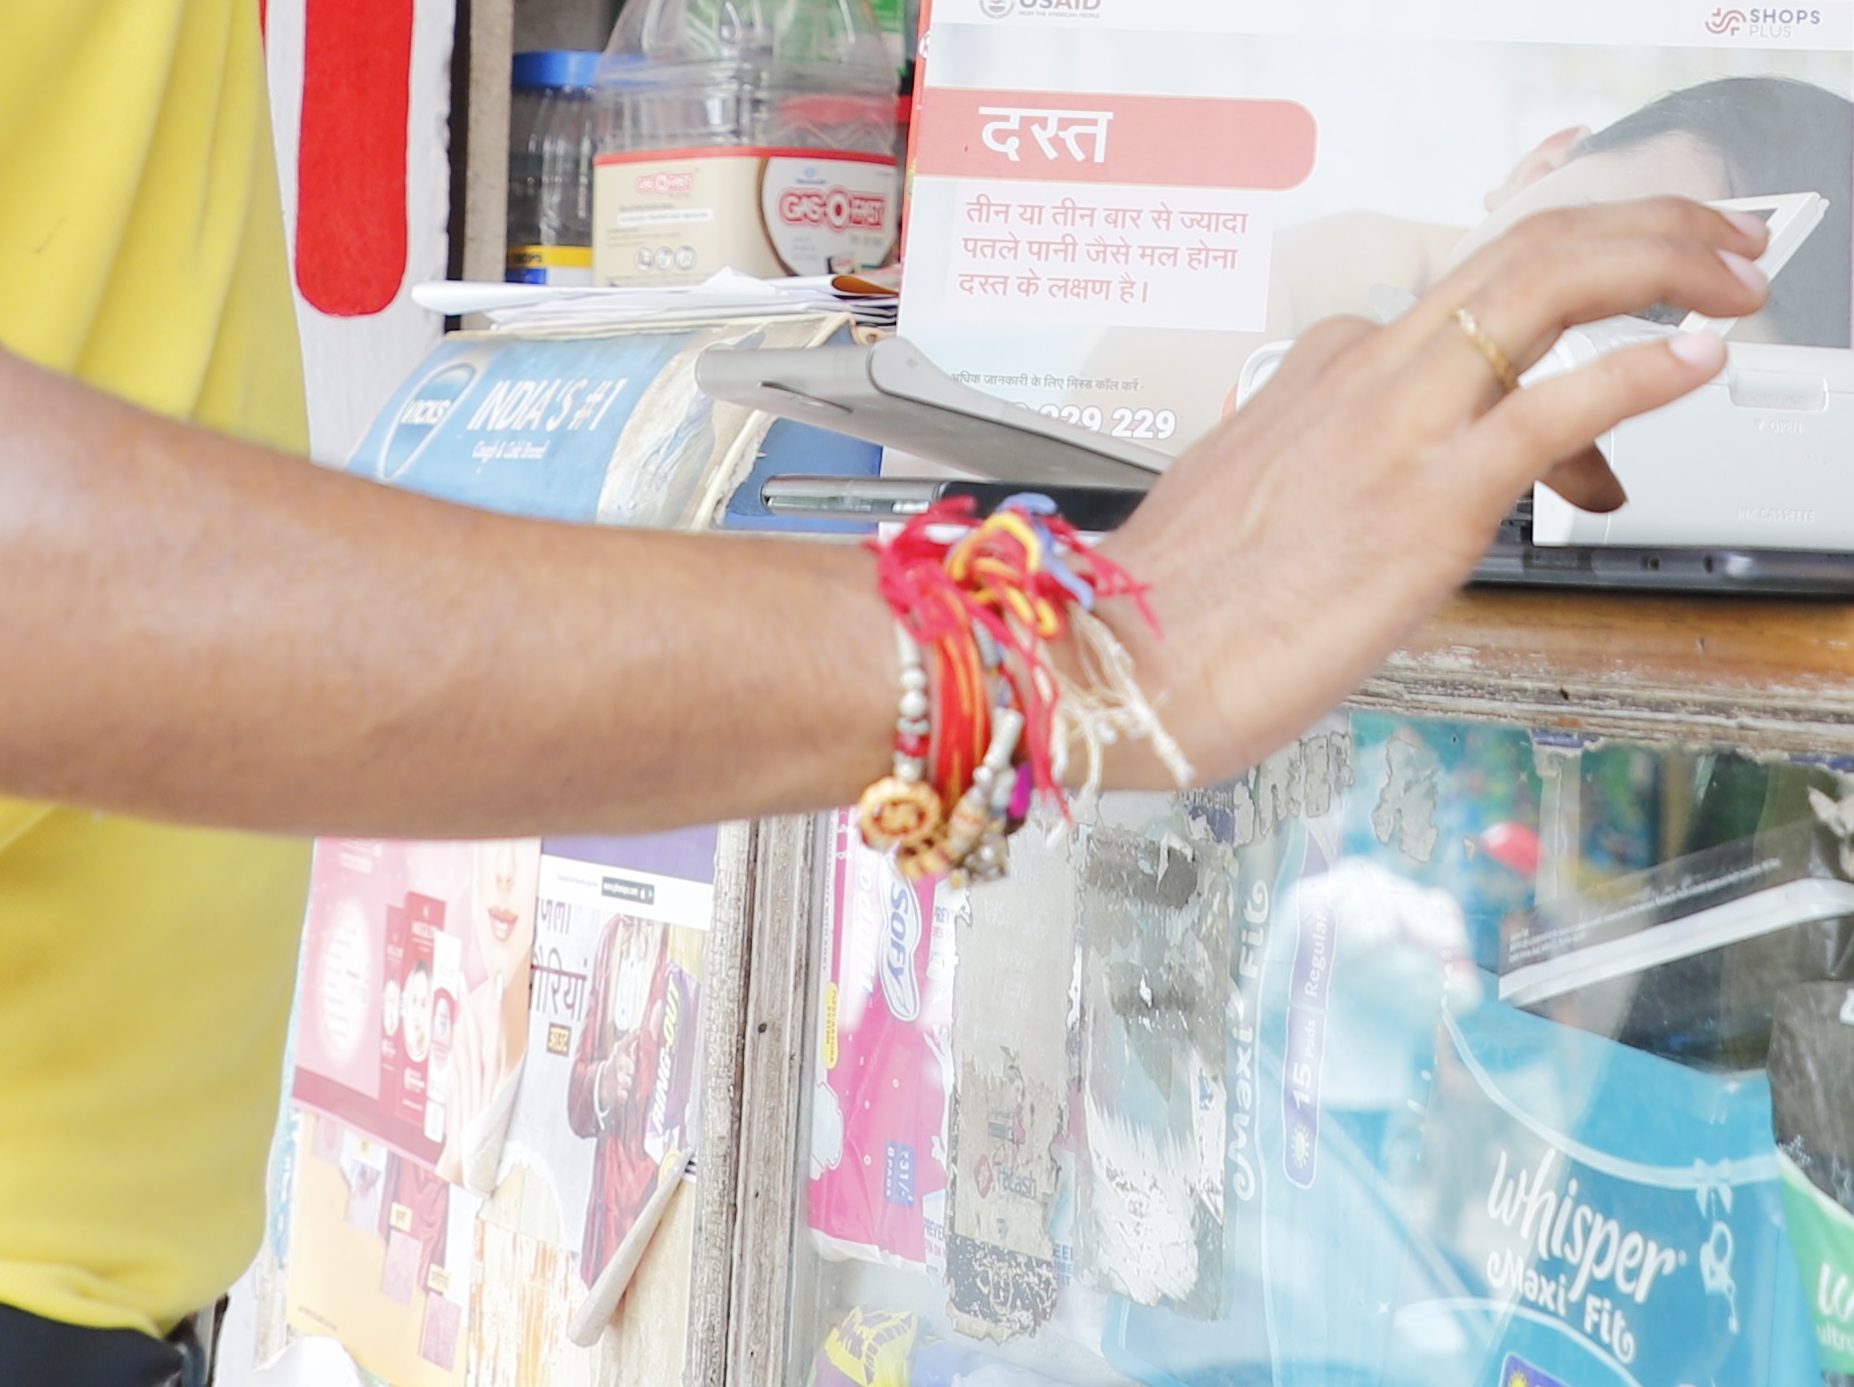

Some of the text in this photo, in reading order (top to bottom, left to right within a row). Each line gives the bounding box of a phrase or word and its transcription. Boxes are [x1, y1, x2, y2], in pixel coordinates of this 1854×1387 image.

[1749, 24, 1792, 38] PLUS
[1750, 8, 1821, 25] SHOPS
[979, 106, 1114, 164] दस्त
[965, 193, 1250, 235] तीन या तीन बार से ज्यादा
[962, 230, 1239, 271] पतले पानी जैसे मल होना
[958, 272, 1010, 297] दस्त
[1016, 268, 1042, 299] के
[1047, 276, 1113, 302] लक्षण
[983, 373, 1029, 388] जानकारी
[1031, 374, 1042, 388] के
[1043, 375, 1065, 390] लिए
[1096, 376, 1120, 392] कॉल
[401, 399, 451, 424] VICKS
[466, 378, 589, 431] INDIA'S
[1111, 406, 1178, 441] 229
[1770, 419, 1803, 434] OPEN
[1758, 508, 1816, 523] CASSETTE
[886, 881, 909, 979] SOFY
[1304, 908, 1328, 998] Regular
[651, 973, 680, 1135] RING-OUT
[1228, 878, 1269, 1202] Maxi Fit
[1292, 1062, 1313, 1111] 15
[1487, 1146, 1678, 1305] whisper
[1486, 1246, 1637, 1365] Maxi Fit
